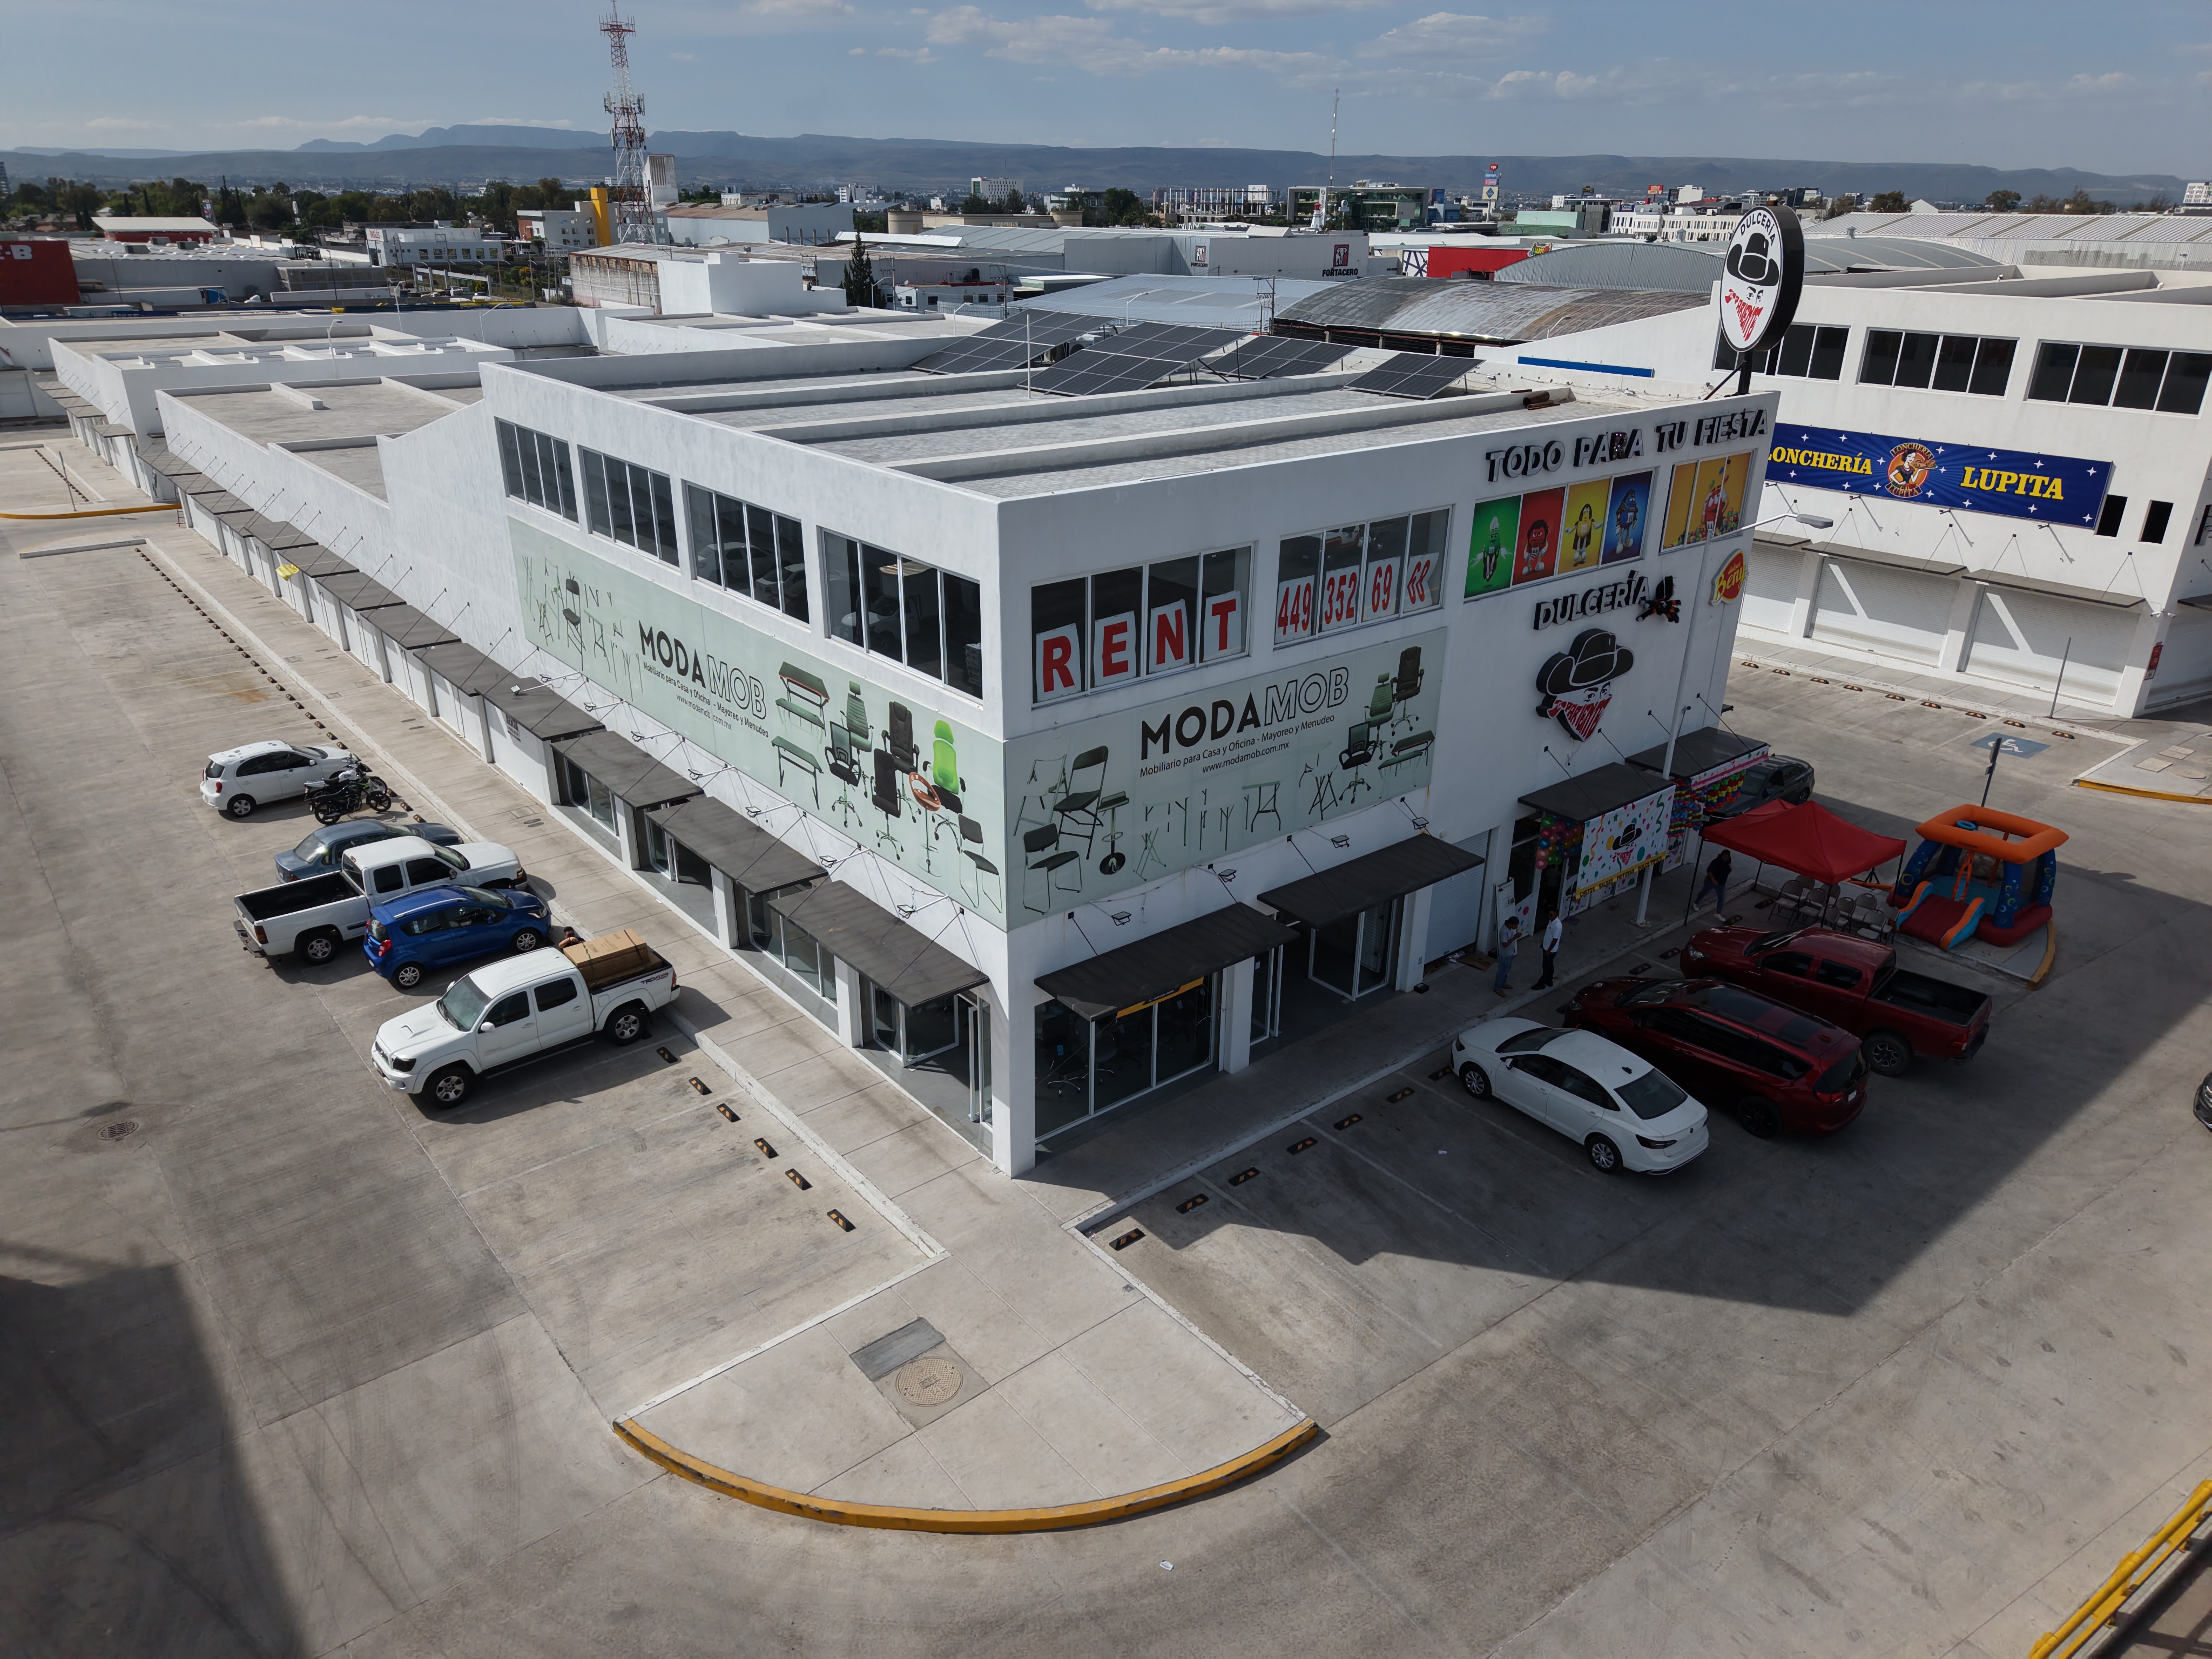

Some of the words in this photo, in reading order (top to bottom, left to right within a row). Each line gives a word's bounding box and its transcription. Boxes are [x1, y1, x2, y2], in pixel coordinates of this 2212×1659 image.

[1740, 212, 1776, 246] DULCERÍA
[1322, 267, 1358, 276] FORTACERO
[1486, 440, 1565, 482] TODO
[1574, 429, 1644, 467] PARA
[1656, 421, 1689, 453] TU
[1695, 409, 1768, 446] FIESTA
[1892, 443, 1933, 460] LONCHERIA
[1888, 485, 1920, 497] LUPITA
[1960, 467, 2064, 500] LUPITA
[1278, 582, 1312, 636] 449
[1325, 572, 1357, 624] 352
[1372, 564, 1392, 613] 69
[1533, 570, 1650, 631] DULCERÍA
[1713, 564, 1746, 603] Beny
[639, 620, 767, 720] MODAMOB
[1043, 598, 1236, 693] RENT
[643, 661, 665, 680] Mobiliario
[666, 676, 676, 687] para
[677, 680, 689, 693] Casa
[693, 689, 710, 706] Oficina
[717, 702, 739, 721] Mayoreo
[740, 716, 743, 725] y
[745, 717, 769, 738] Menudeo
[1141, 666, 1349, 761] MODAMOB
[1140, 759, 1181, 778] Mobiliario
[1183, 754, 1201, 767] para
[1203, 747, 1221, 759] Casa
[1222, 746, 1228, 756] y
[1229, 738, 1256, 752] Oficina
[1262, 727, 1294, 743] Mayoreo
[1294, 725, 1300, 734] y
[1301, 713, 1335, 731] Menudeo
[1202, 742, 1290, 773] www.modamob.com.mx
[1580, 886, 1595, 898] CHETOS
[1599, 878, 1613, 889] SALSAS
[1616, 868, 1635, 881] FRITURAS
